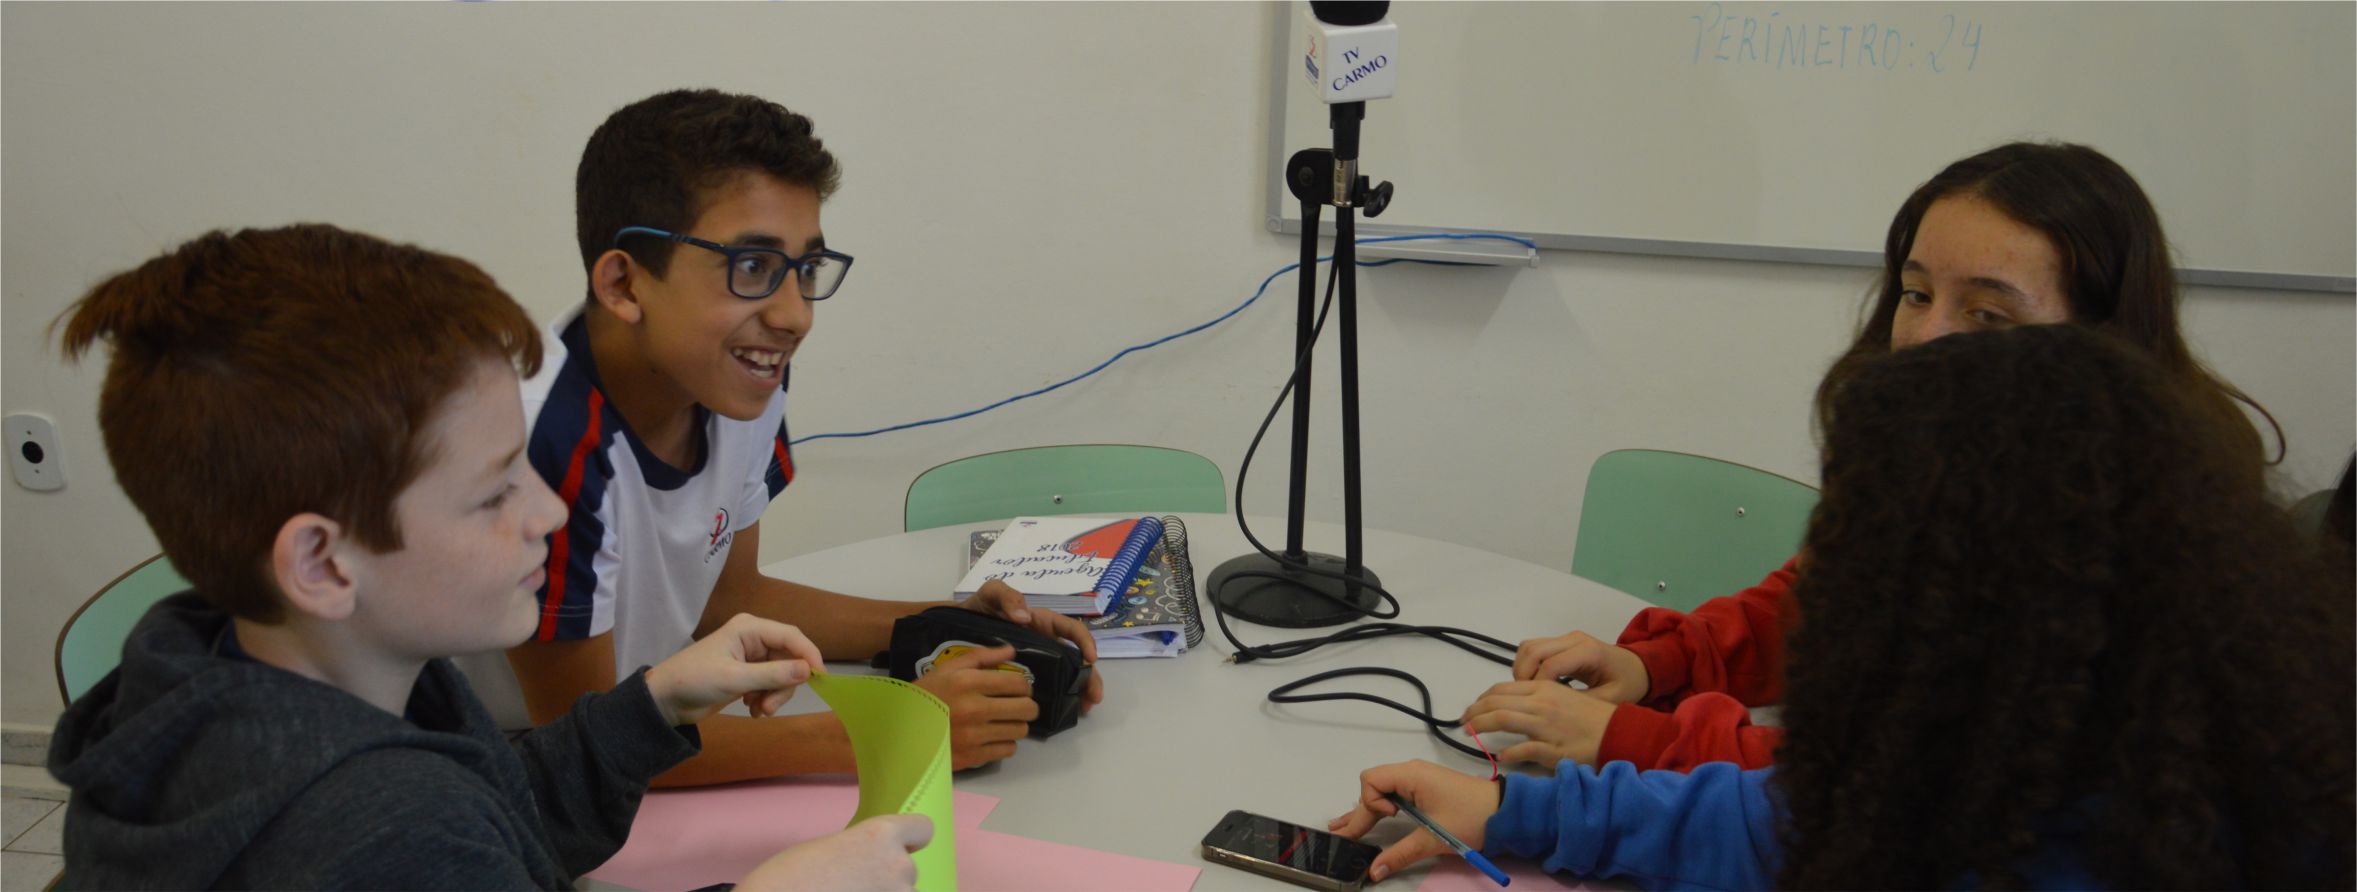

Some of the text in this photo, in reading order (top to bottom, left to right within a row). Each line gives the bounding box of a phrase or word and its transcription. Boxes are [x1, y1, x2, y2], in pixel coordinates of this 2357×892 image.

[1928, 14, 1982, 73] 24
[1342, 46, 1360, 64] TV
[1332, 55, 1388, 91] CARMO
[1037, 541, 1083, 552] 2018
[990, 552, 1098, 568] Educador
[1022, 562, 1104, 580] Agenda
